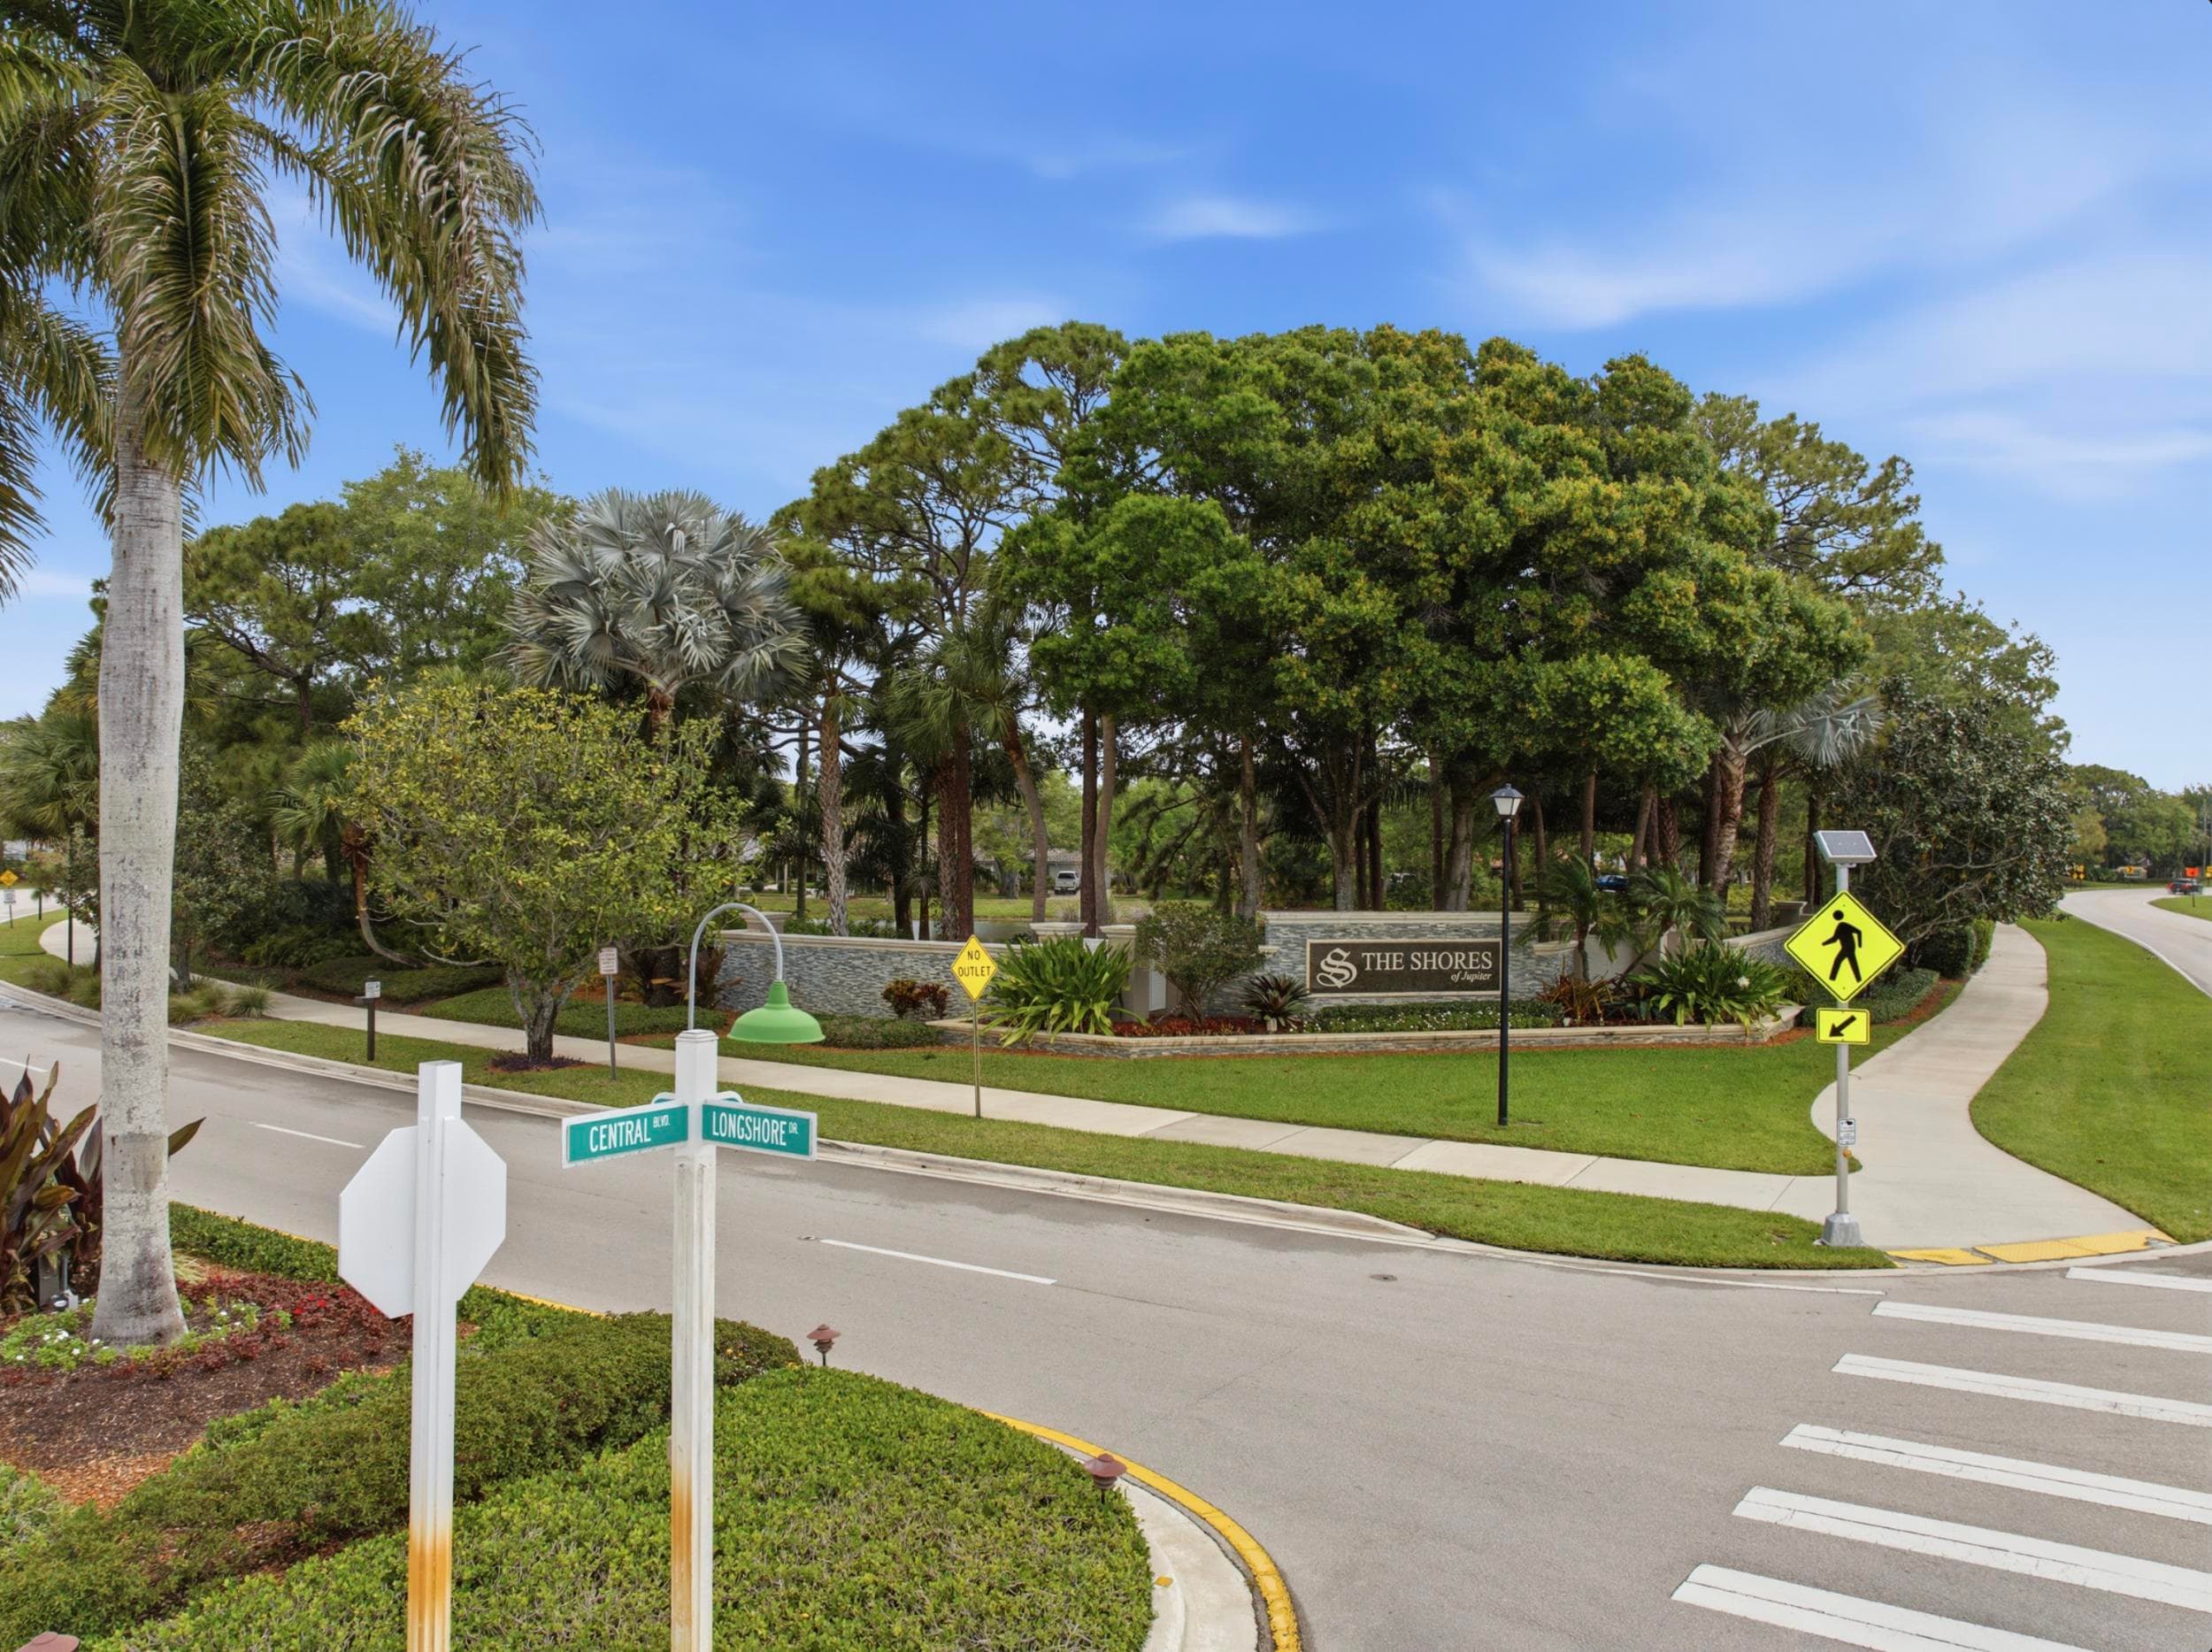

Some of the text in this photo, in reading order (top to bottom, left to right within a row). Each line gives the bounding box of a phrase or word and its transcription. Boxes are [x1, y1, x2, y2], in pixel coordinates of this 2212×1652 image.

[968, 950, 980, 960] NO
[1362, 951, 1493, 971] THE SHORES
[958, 966, 991, 977] OUTLET
[1451, 971, 1493, 982] of Jupiter
[589, 1118, 651, 1152] CENTRAL
[711, 1110, 787, 1147] LONGSHORE
